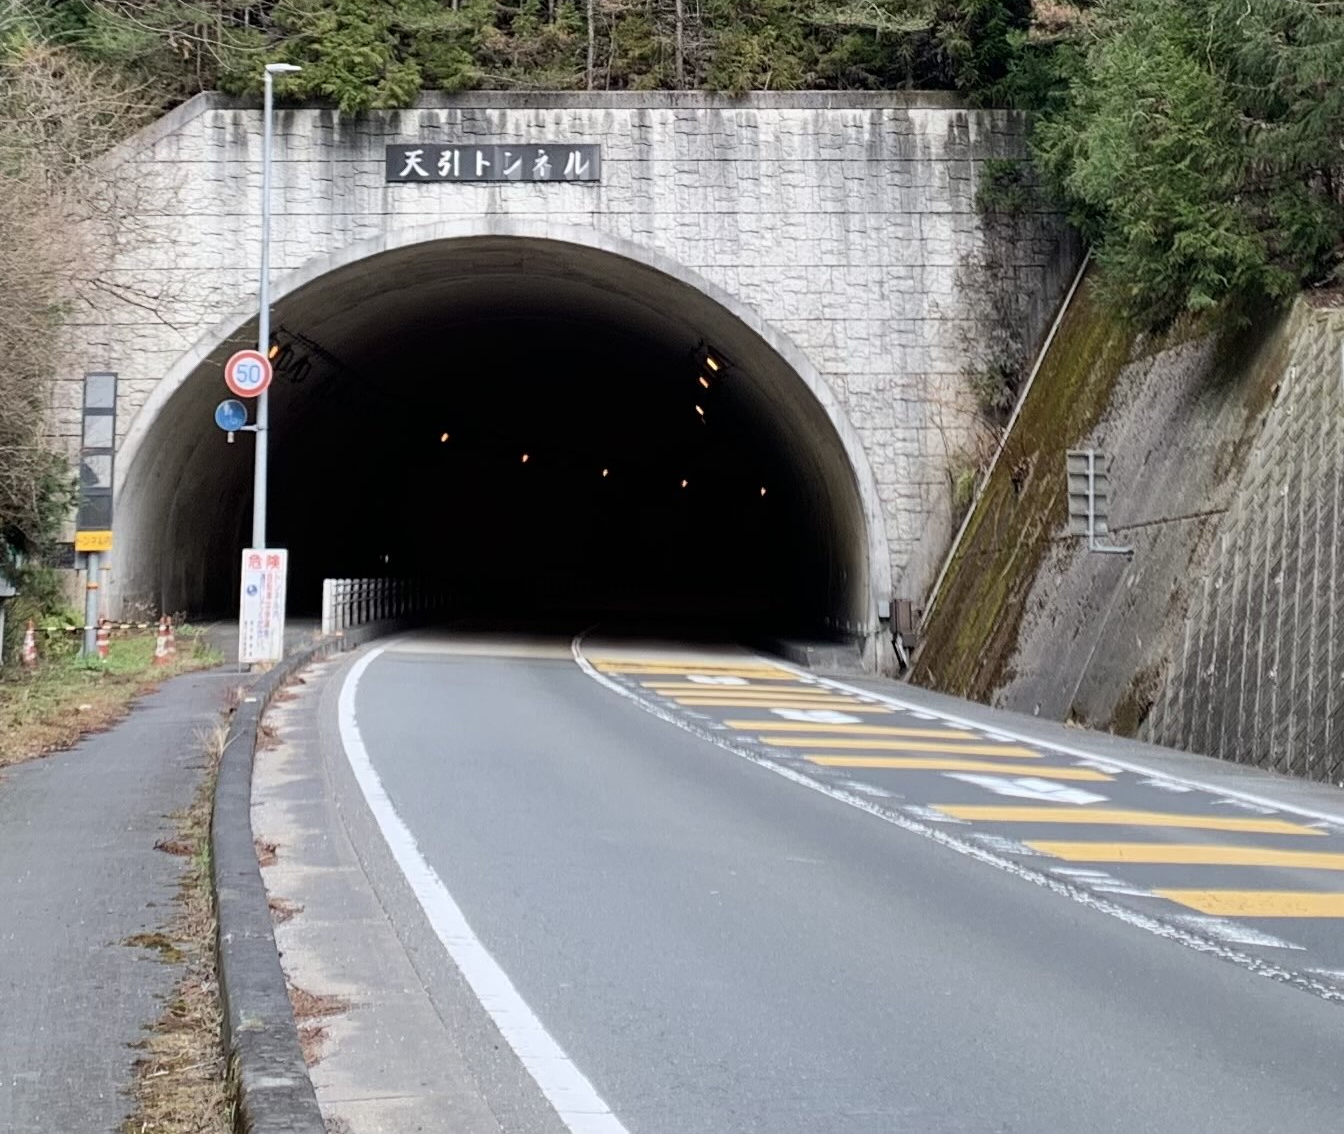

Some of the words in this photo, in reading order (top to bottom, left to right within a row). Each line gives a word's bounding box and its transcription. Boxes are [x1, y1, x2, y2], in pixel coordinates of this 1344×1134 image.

[399, 149, 590, 178] 天引トンネル
[236, 364, 260, 383] 50
[249, 554, 281, 569] 危険
